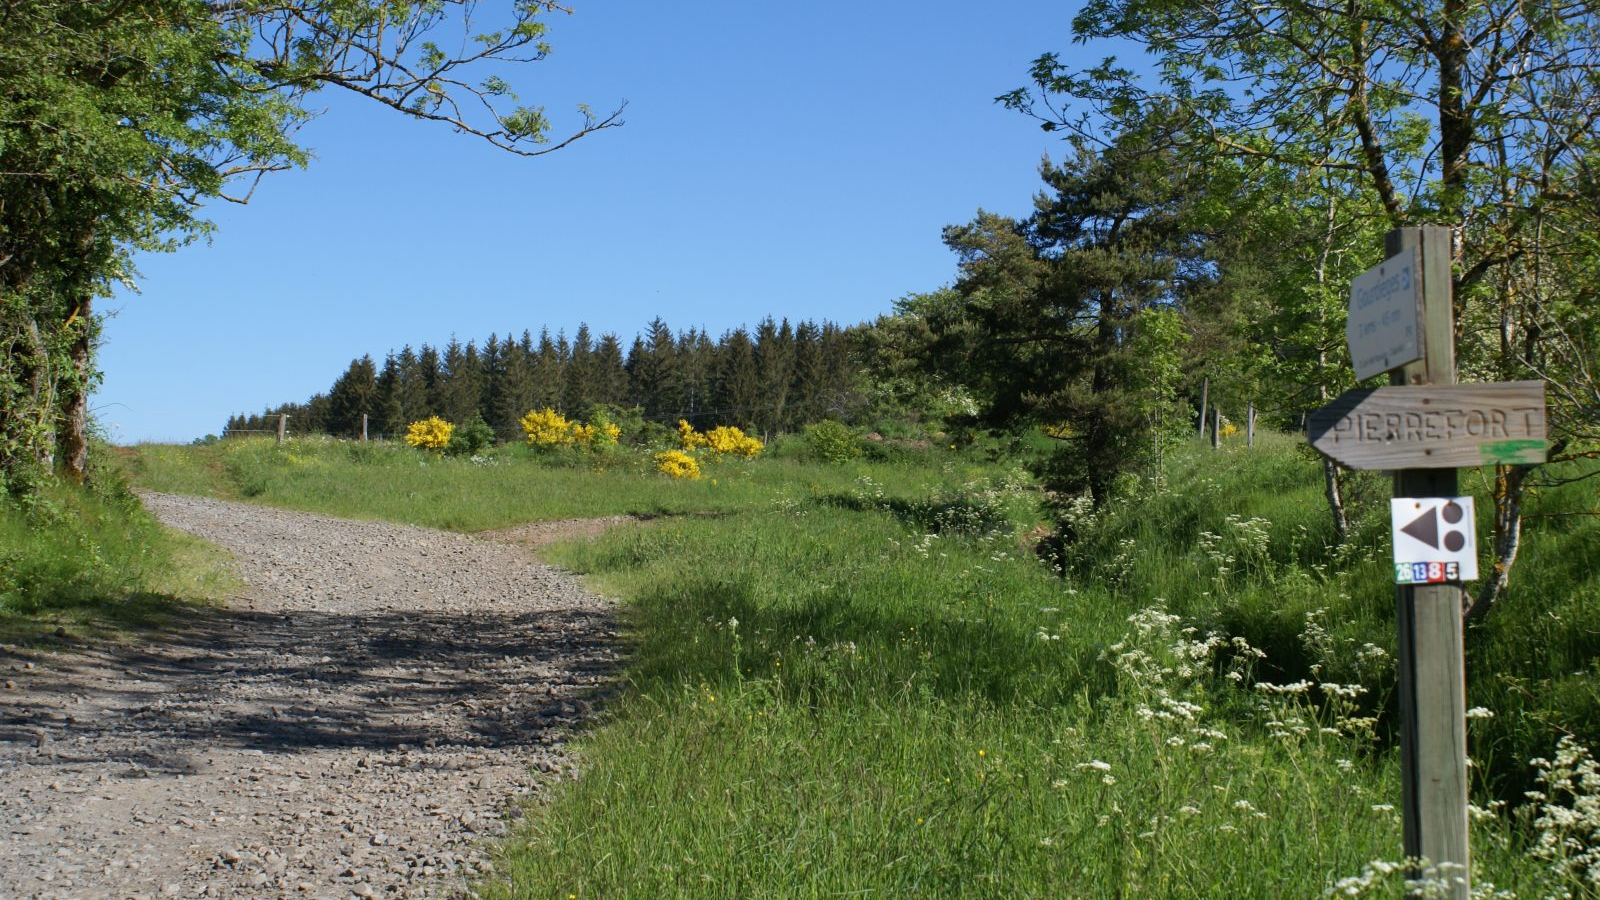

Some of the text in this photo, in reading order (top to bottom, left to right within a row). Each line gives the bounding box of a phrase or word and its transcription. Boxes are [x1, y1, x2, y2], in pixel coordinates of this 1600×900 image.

[1334, 408, 1539, 442] PIERREFORT
[1396, 562, 1458, 581] 26 13 8 5
